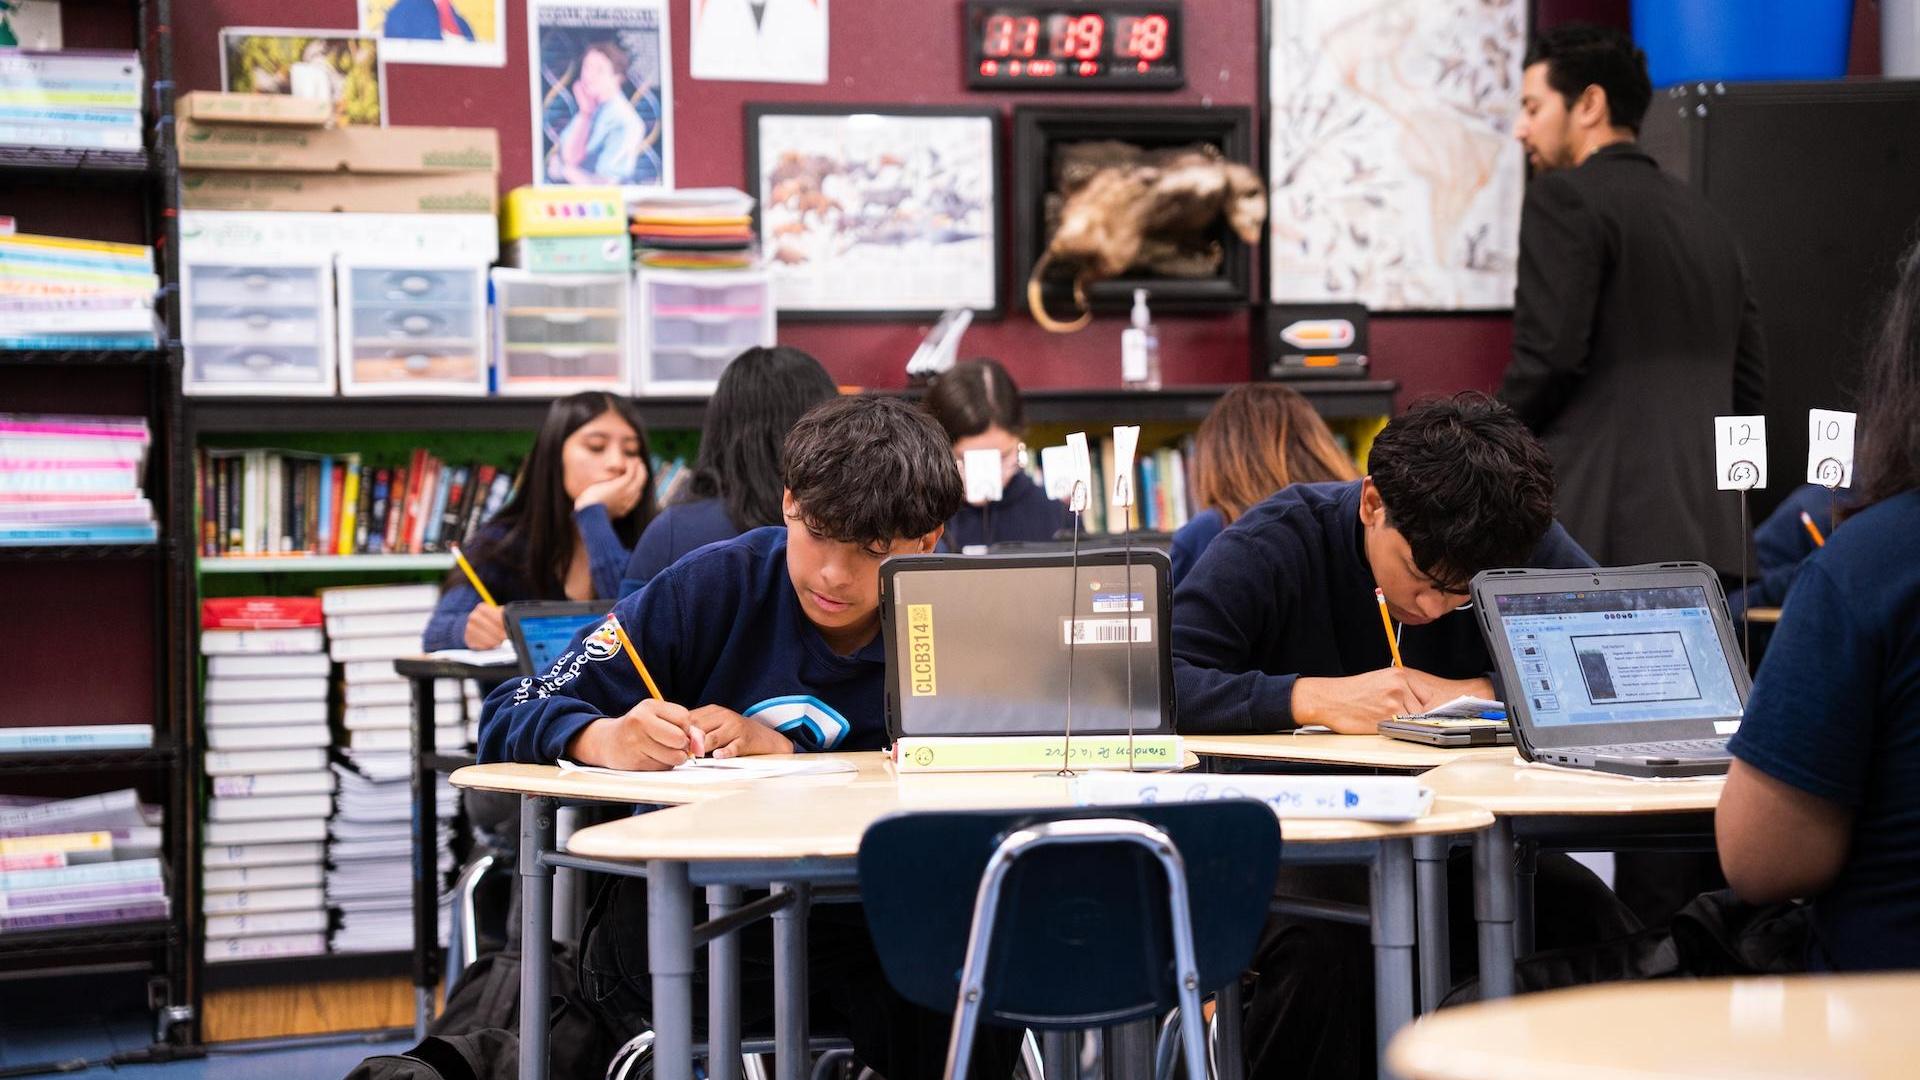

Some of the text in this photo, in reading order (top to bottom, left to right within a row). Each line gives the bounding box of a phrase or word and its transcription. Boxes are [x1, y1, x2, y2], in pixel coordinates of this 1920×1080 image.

[990, 14, 1168, 59] 11 19 18
[1730, 424, 1761, 446] 12
[1817, 420, 1840, 441] 10
[1733, 466, 1751, 482] G3
[913, 623, 933, 693] CLCB314
